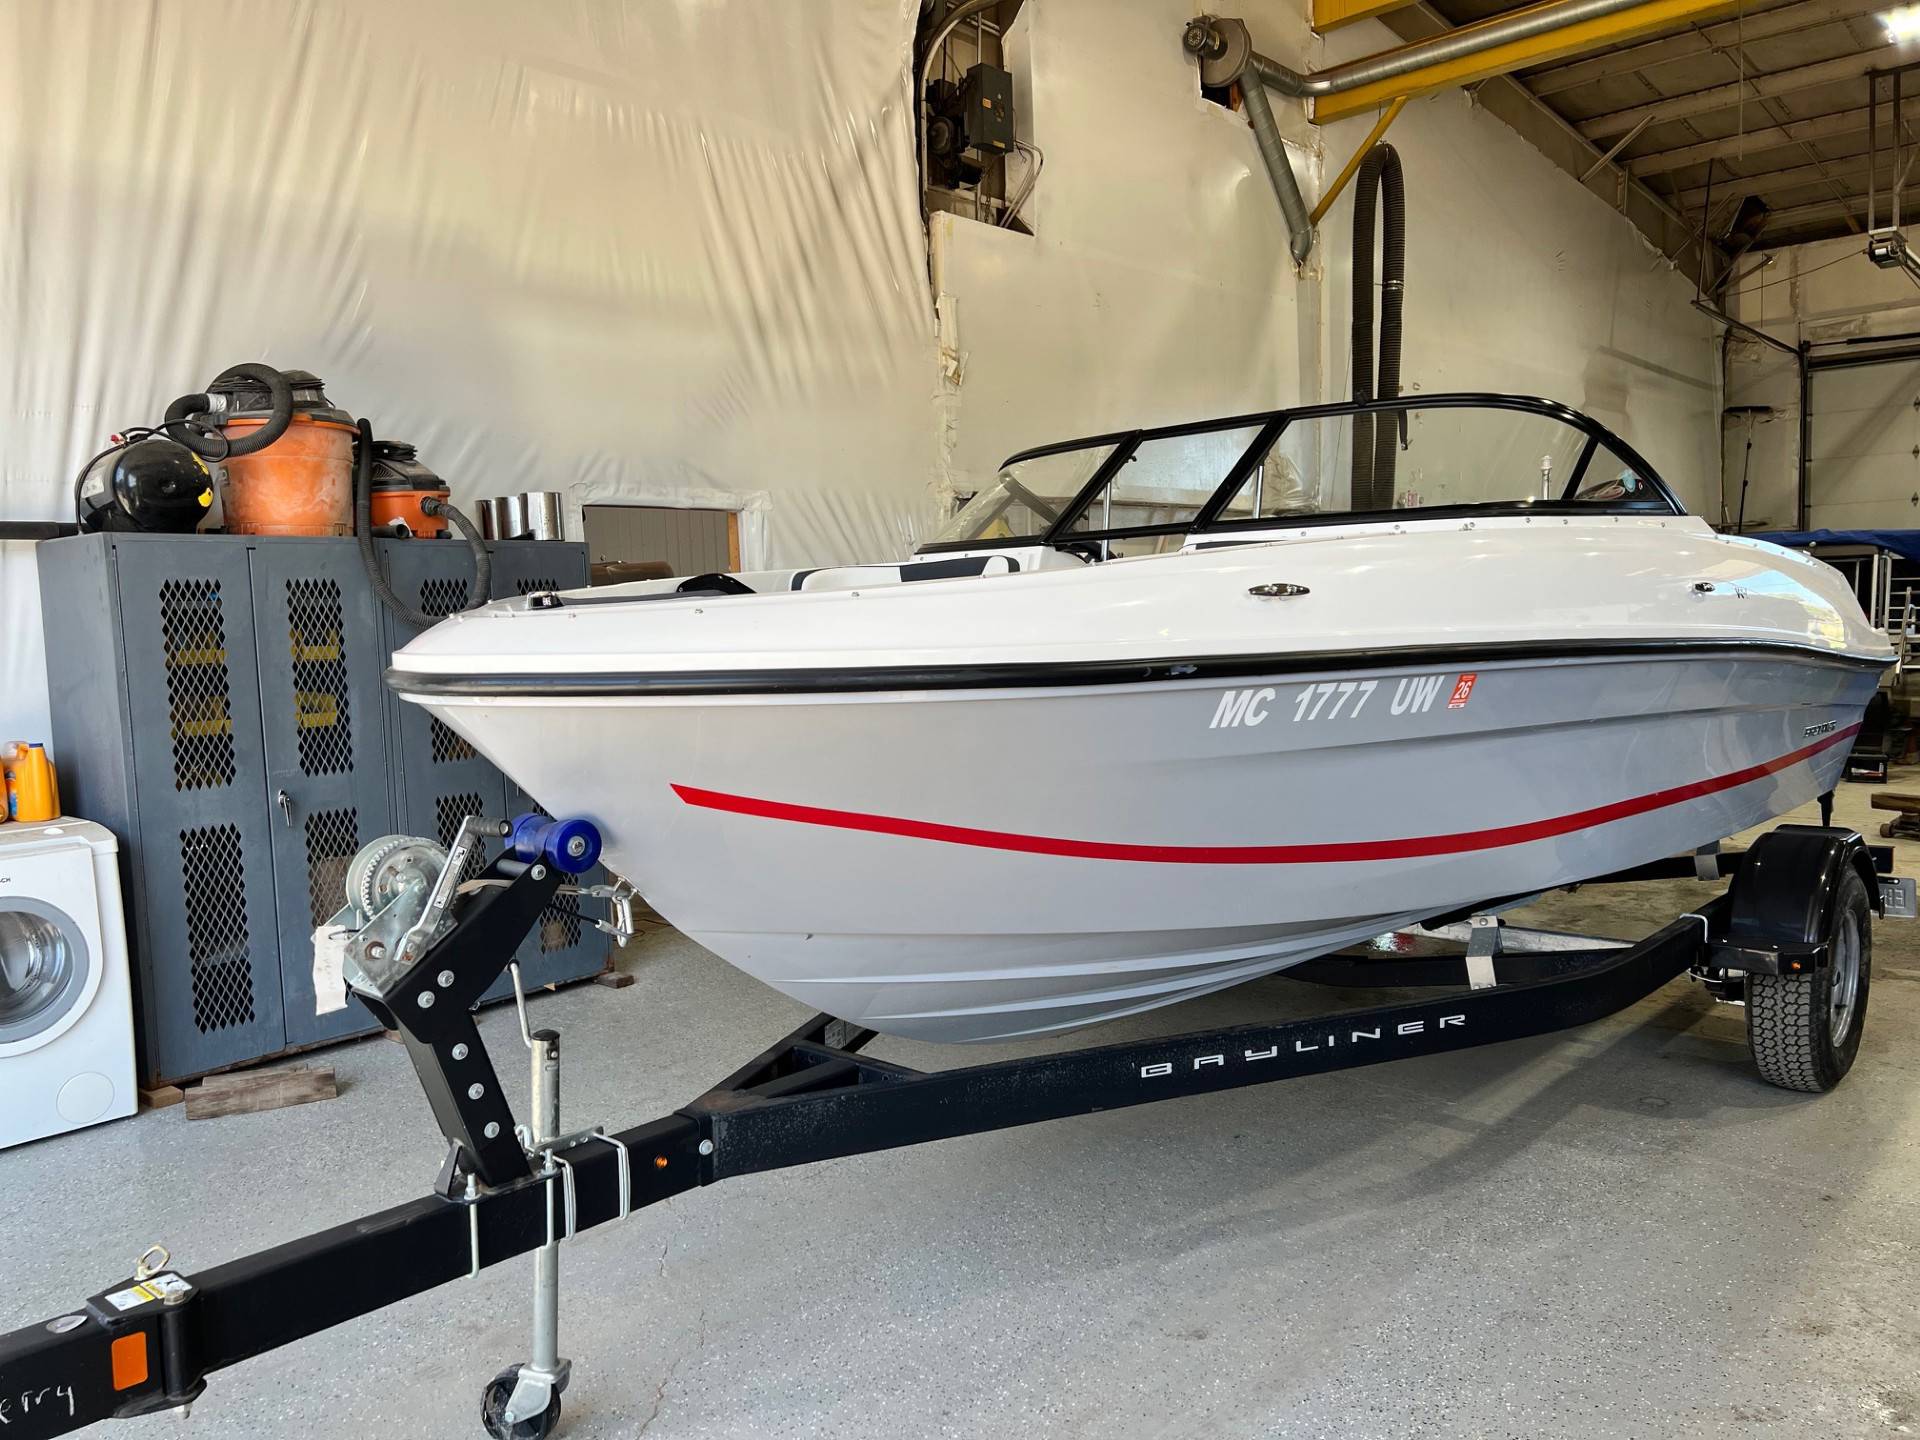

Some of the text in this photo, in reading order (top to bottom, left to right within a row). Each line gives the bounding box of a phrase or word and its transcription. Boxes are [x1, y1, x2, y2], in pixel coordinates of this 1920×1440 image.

[1208, 675, 1445, 729] MC 1777 UW
[1453, 680, 1472, 699] 26
[1140, 1014, 1466, 1079] BAYLINER
